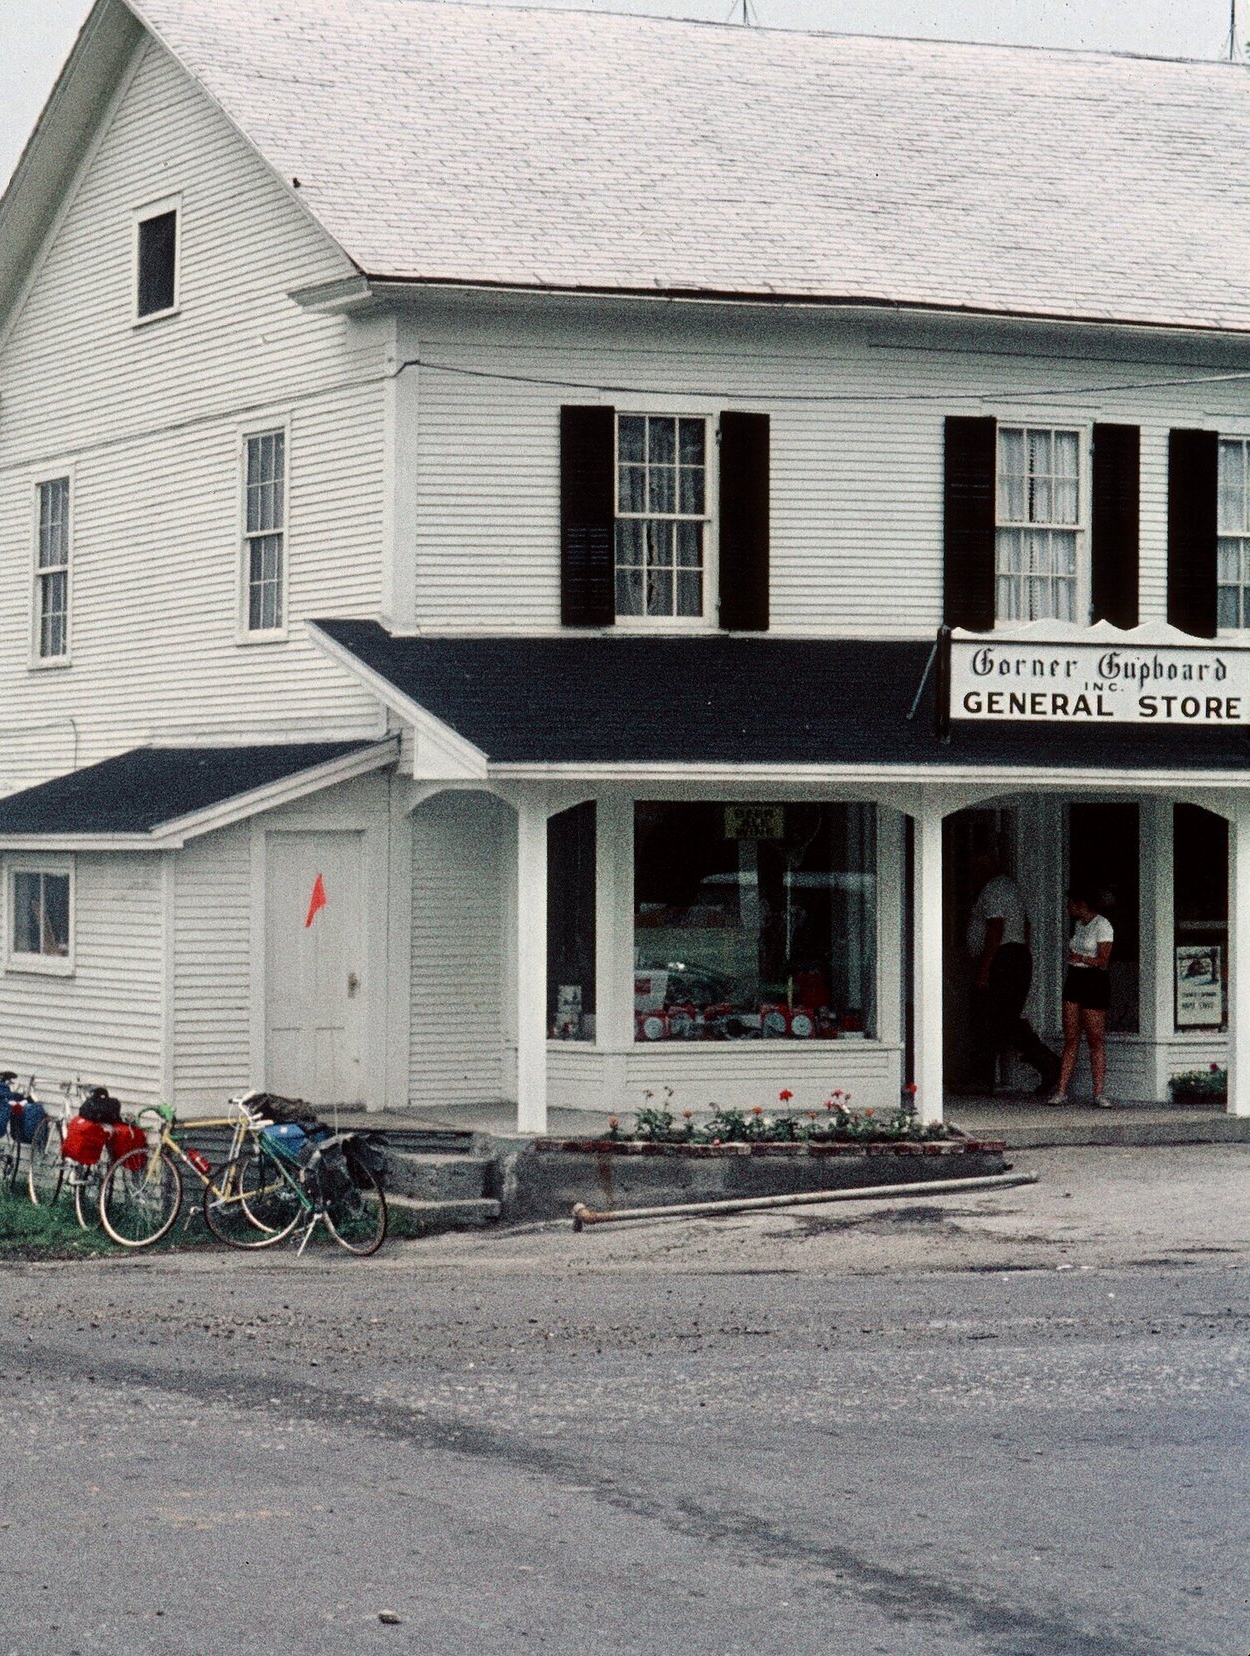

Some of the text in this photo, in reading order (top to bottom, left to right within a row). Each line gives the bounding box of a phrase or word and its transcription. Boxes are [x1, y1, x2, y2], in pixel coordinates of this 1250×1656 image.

[972, 648, 1227, 689] Corner Cupboard
[1084, 681, 1124, 692] INC.
[963, 691, 1242, 719] GENERAL STORE
